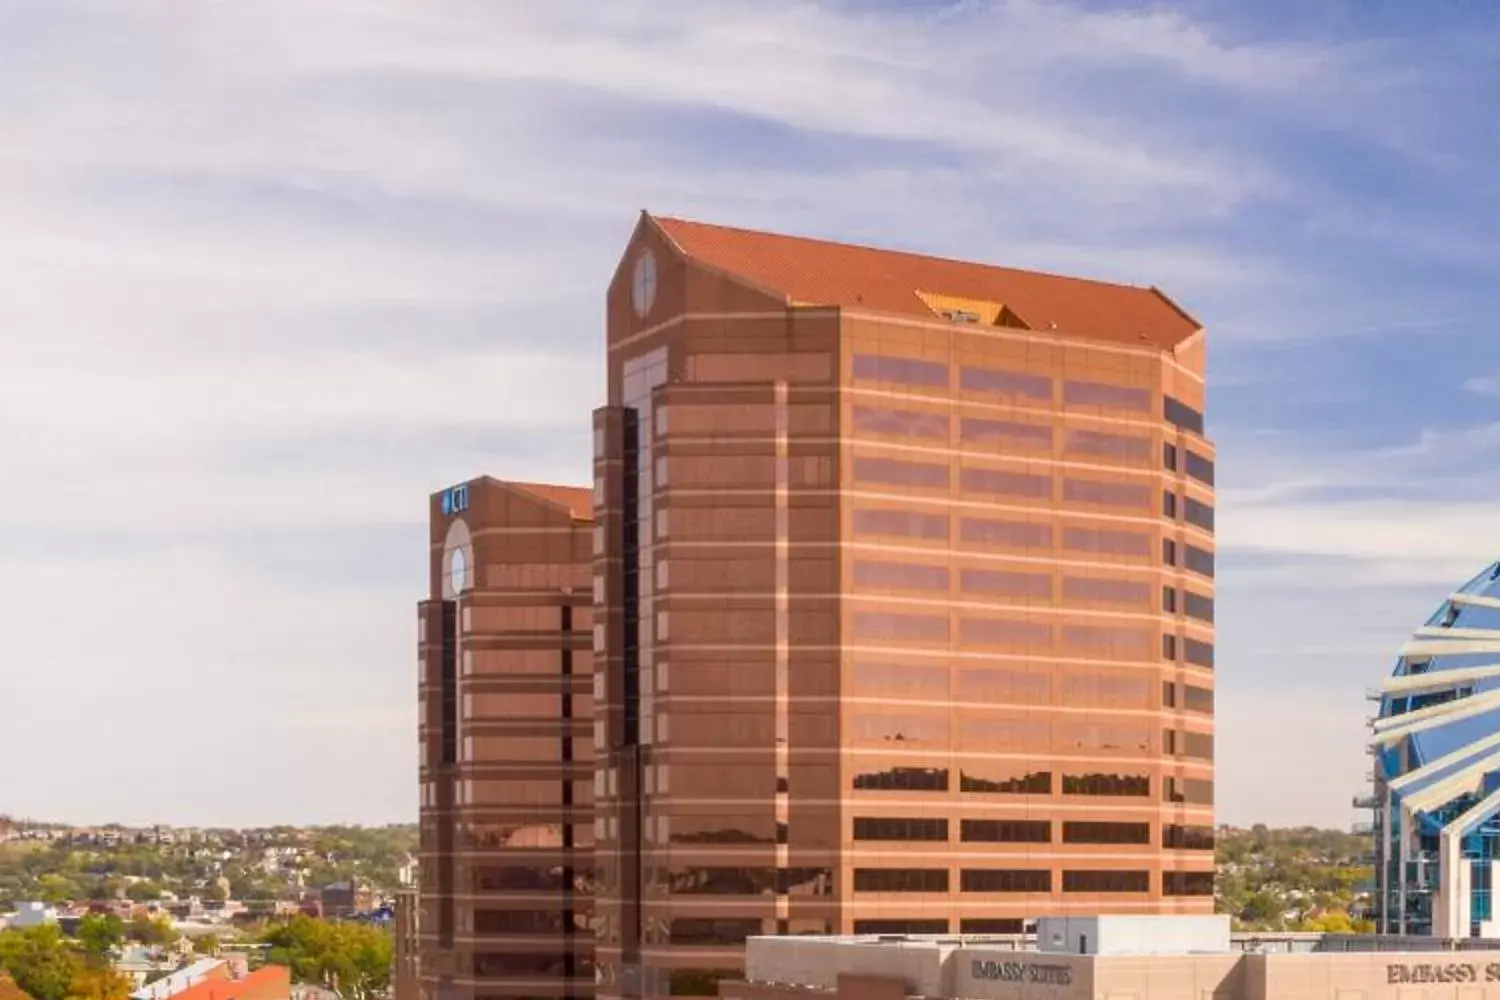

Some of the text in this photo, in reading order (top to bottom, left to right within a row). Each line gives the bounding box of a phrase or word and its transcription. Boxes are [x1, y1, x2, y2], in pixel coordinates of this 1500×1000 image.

[972, 960, 1073, 985] EMBASSY SUITES
[1387, 964, 1478, 984] EMBASSY
